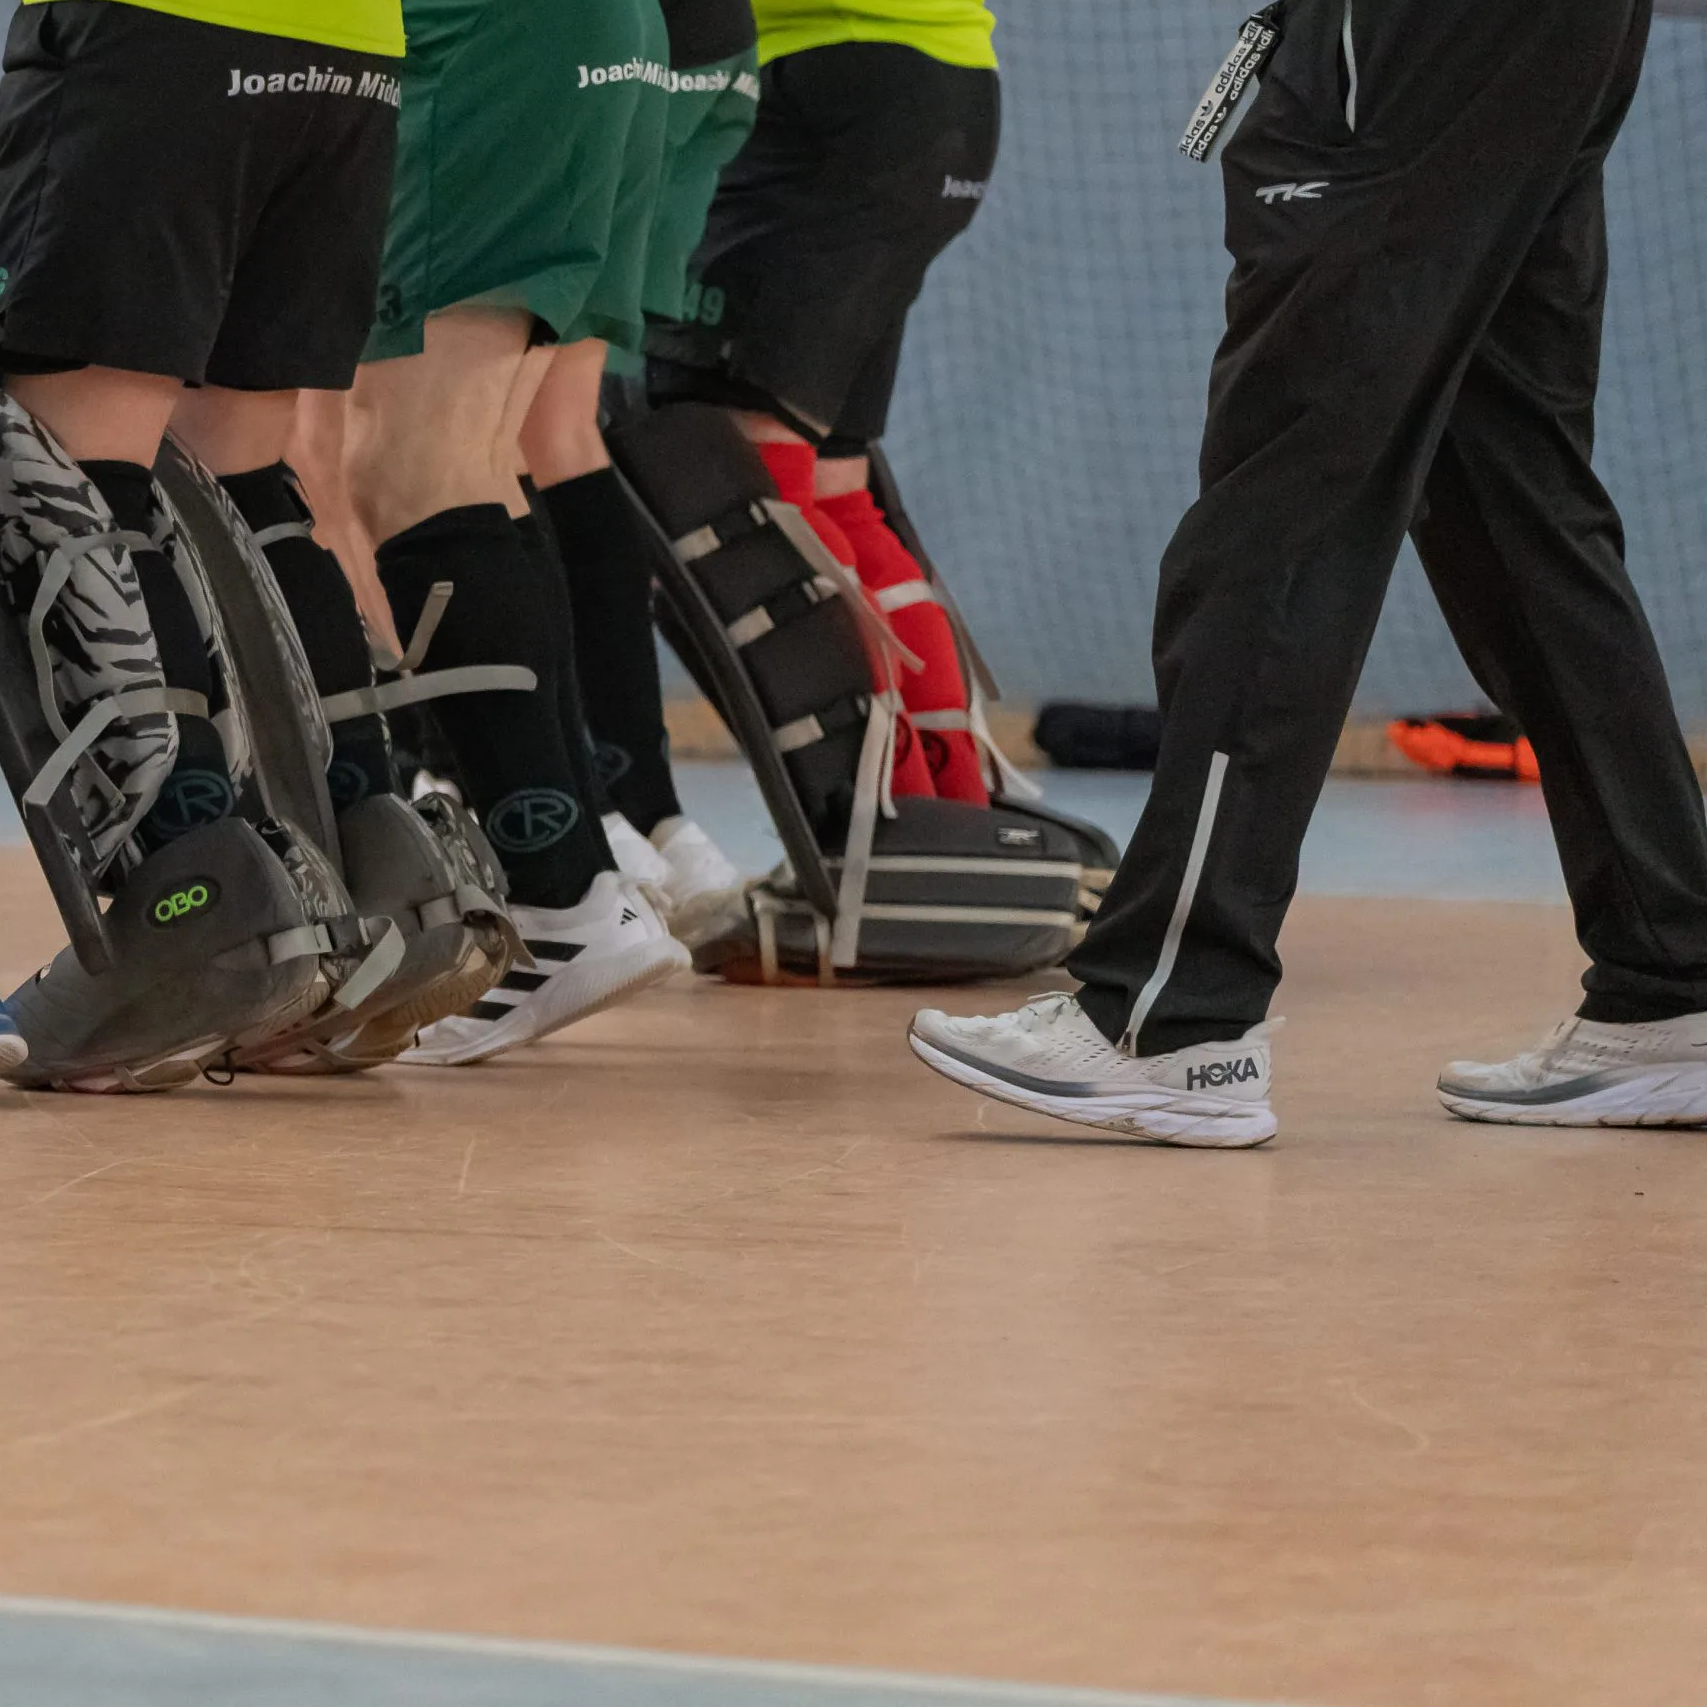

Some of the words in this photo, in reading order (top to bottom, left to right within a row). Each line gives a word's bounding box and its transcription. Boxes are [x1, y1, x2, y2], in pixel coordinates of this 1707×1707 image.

[227, 65, 353, 97] Joachim
[1230, 51, 1262, 101] adidas
[1255, 181, 1330, 205] TK
[155, 885, 208, 922] OBO
[1186, 1057, 1259, 1091] HOKA
